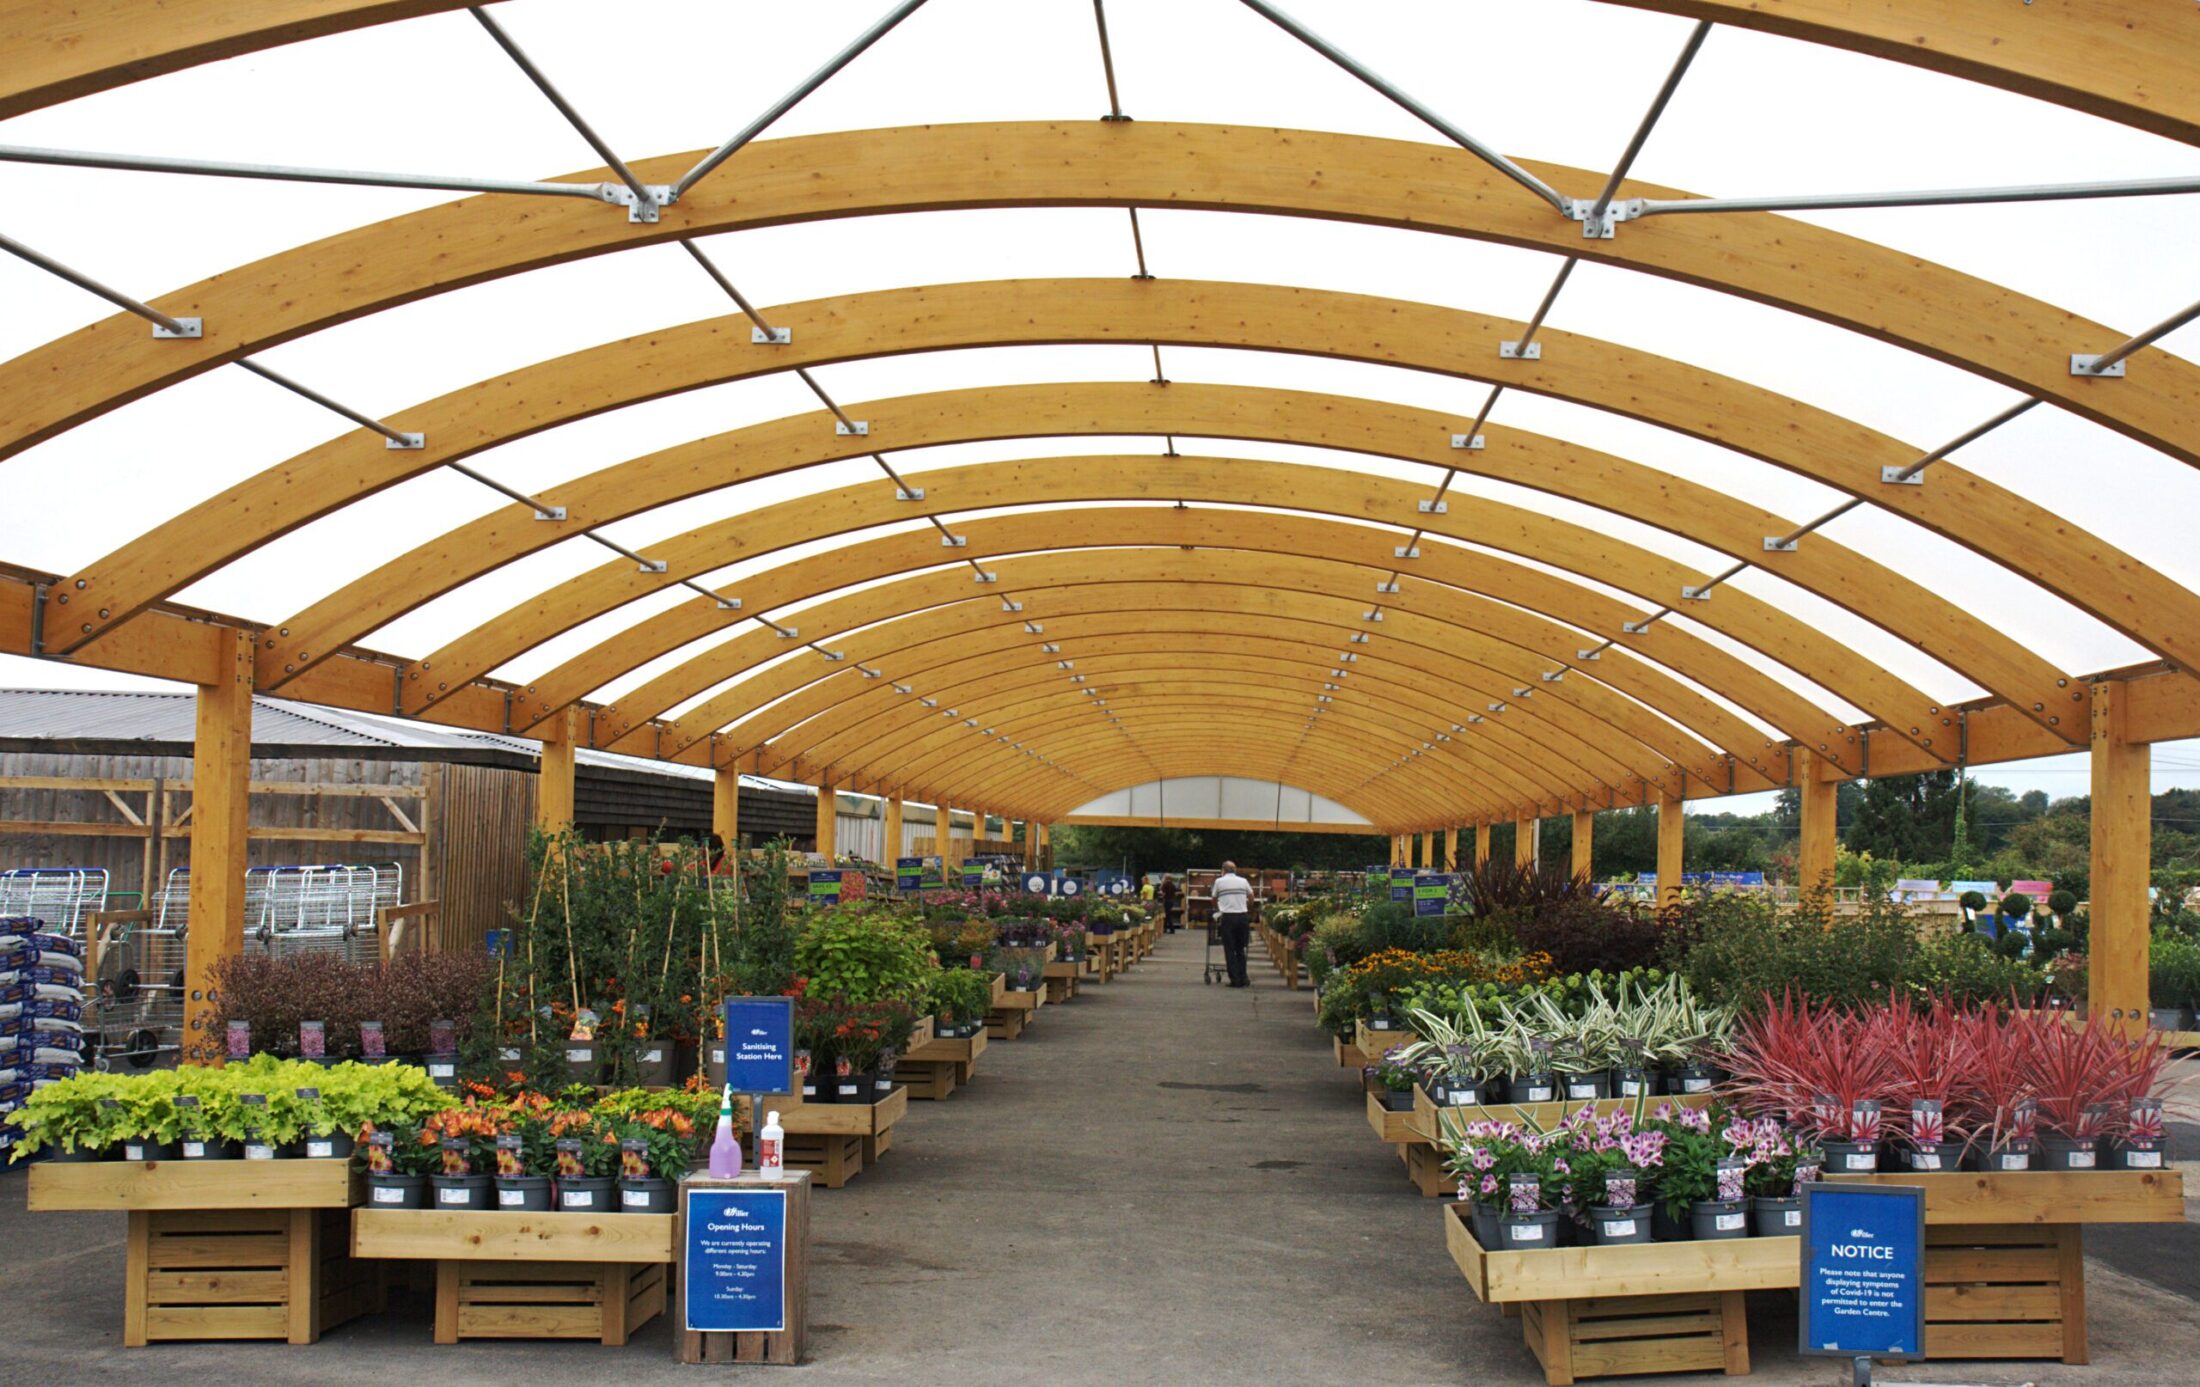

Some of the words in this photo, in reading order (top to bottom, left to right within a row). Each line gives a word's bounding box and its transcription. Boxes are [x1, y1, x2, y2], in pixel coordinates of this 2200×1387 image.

[742, 1042, 777, 1052] Sanitising
[736, 1052, 762, 1061] Station
[763, 1052, 783, 1061] Here
[707, 1222, 740, 1233] Opening
[741, 1222, 765, 1231] Hours
[721, 1239, 745, 1248] currently
[745, 1240, 771, 1248] operating
[1831, 1244, 1894, 1260] NOTICE
[1819, 1267, 1843, 1276] Please
[1844, 1269, 1861, 1277] note
[1862, 1269, 1878, 1278] that
[1878, 1272, 1906, 1280] anyone
[1825, 1278, 1861, 1288] displaying
[1862, 1281, 1900, 1289] symptoms
[1830, 1288, 1839, 1296] of
[1839, 1288, 1873, 1297] Covid-19
[1881, 1290, 1895, 1298] not
[1821, 1298, 1858, 1306] permitted
[1890, 1299, 1903, 1308] the
[1833, 1307, 1861, 1316] Garden
[1862, 1308, 1890, 1317] Centre.
